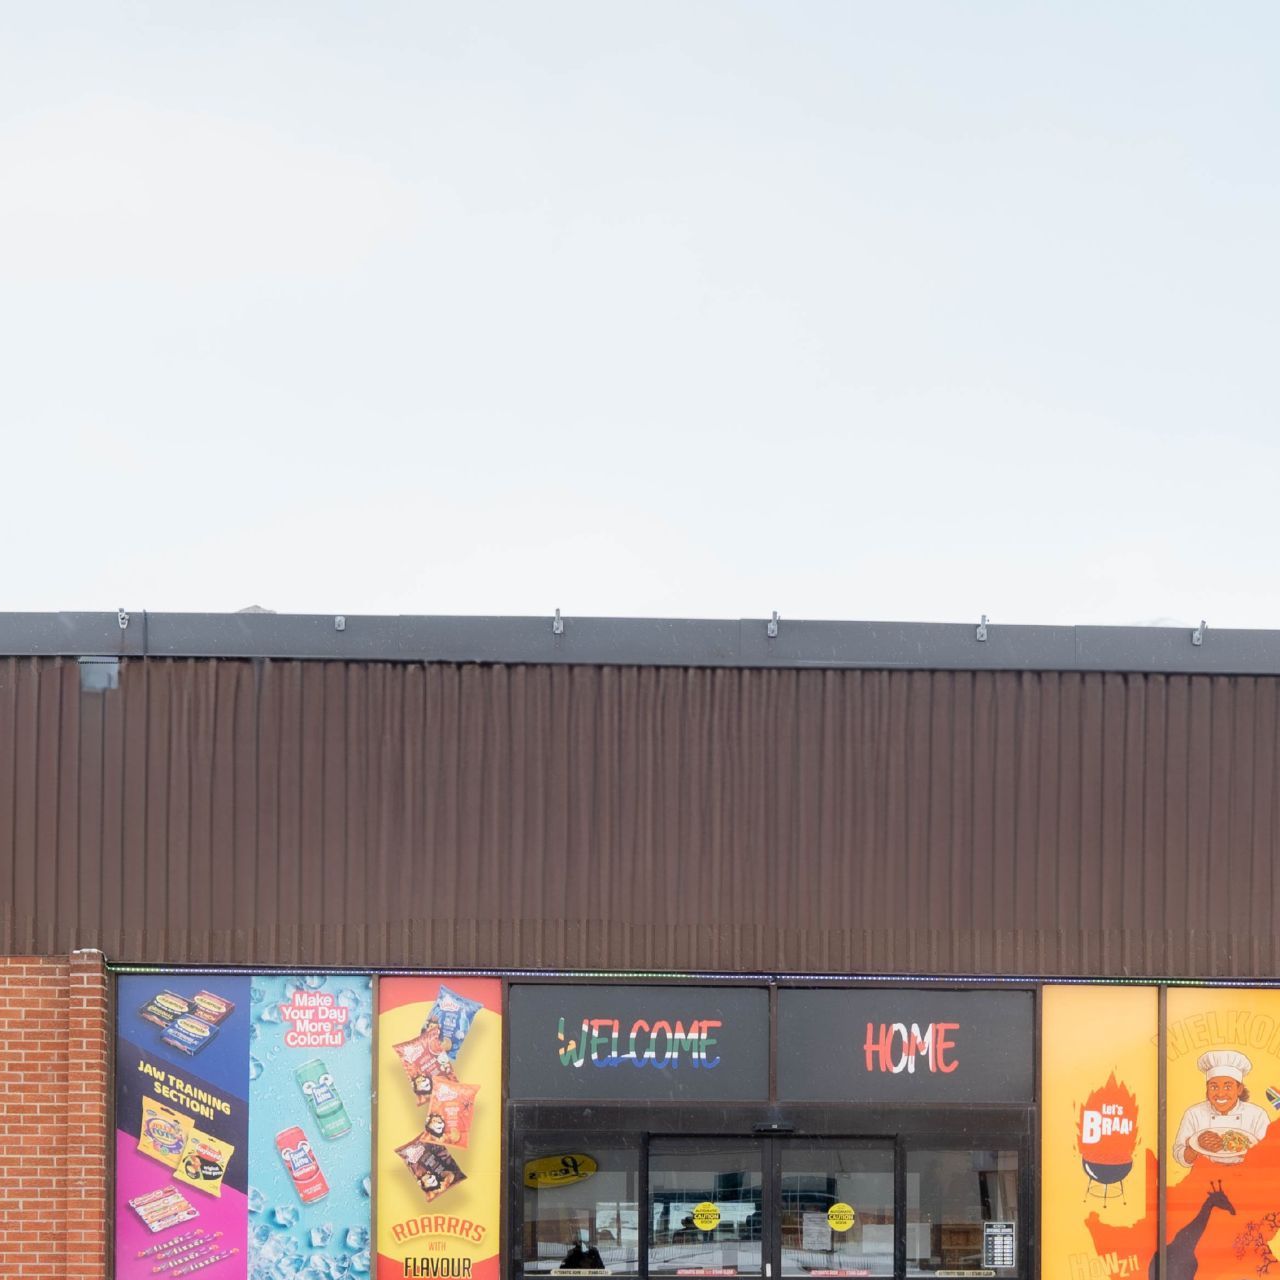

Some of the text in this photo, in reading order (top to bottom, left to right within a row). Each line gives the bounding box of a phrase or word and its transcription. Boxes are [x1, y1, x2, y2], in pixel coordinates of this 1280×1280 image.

[294, 993, 332, 1006] Make
[281, 1006, 347, 1022] Your Day
[296, 1020, 332, 1032] More
[286, 1031, 343, 1046] Colorful
[558, 1017, 723, 1069] WELCOME
[863, 1022, 961, 1074] HOME
[137, 1060, 232, 1116] JAW TRAINING
[153, 1081, 215, 1121] SECTION!
[1102, 1103, 1124, 1116] Let's
[1081, 1109, 1133, 1144] BRAAI
[392, 1215, 486, 1242] ROARRRS
[428, 1242, 447, 1252] WITH
[404, 1257, 471, 1278] FLAVOUR
